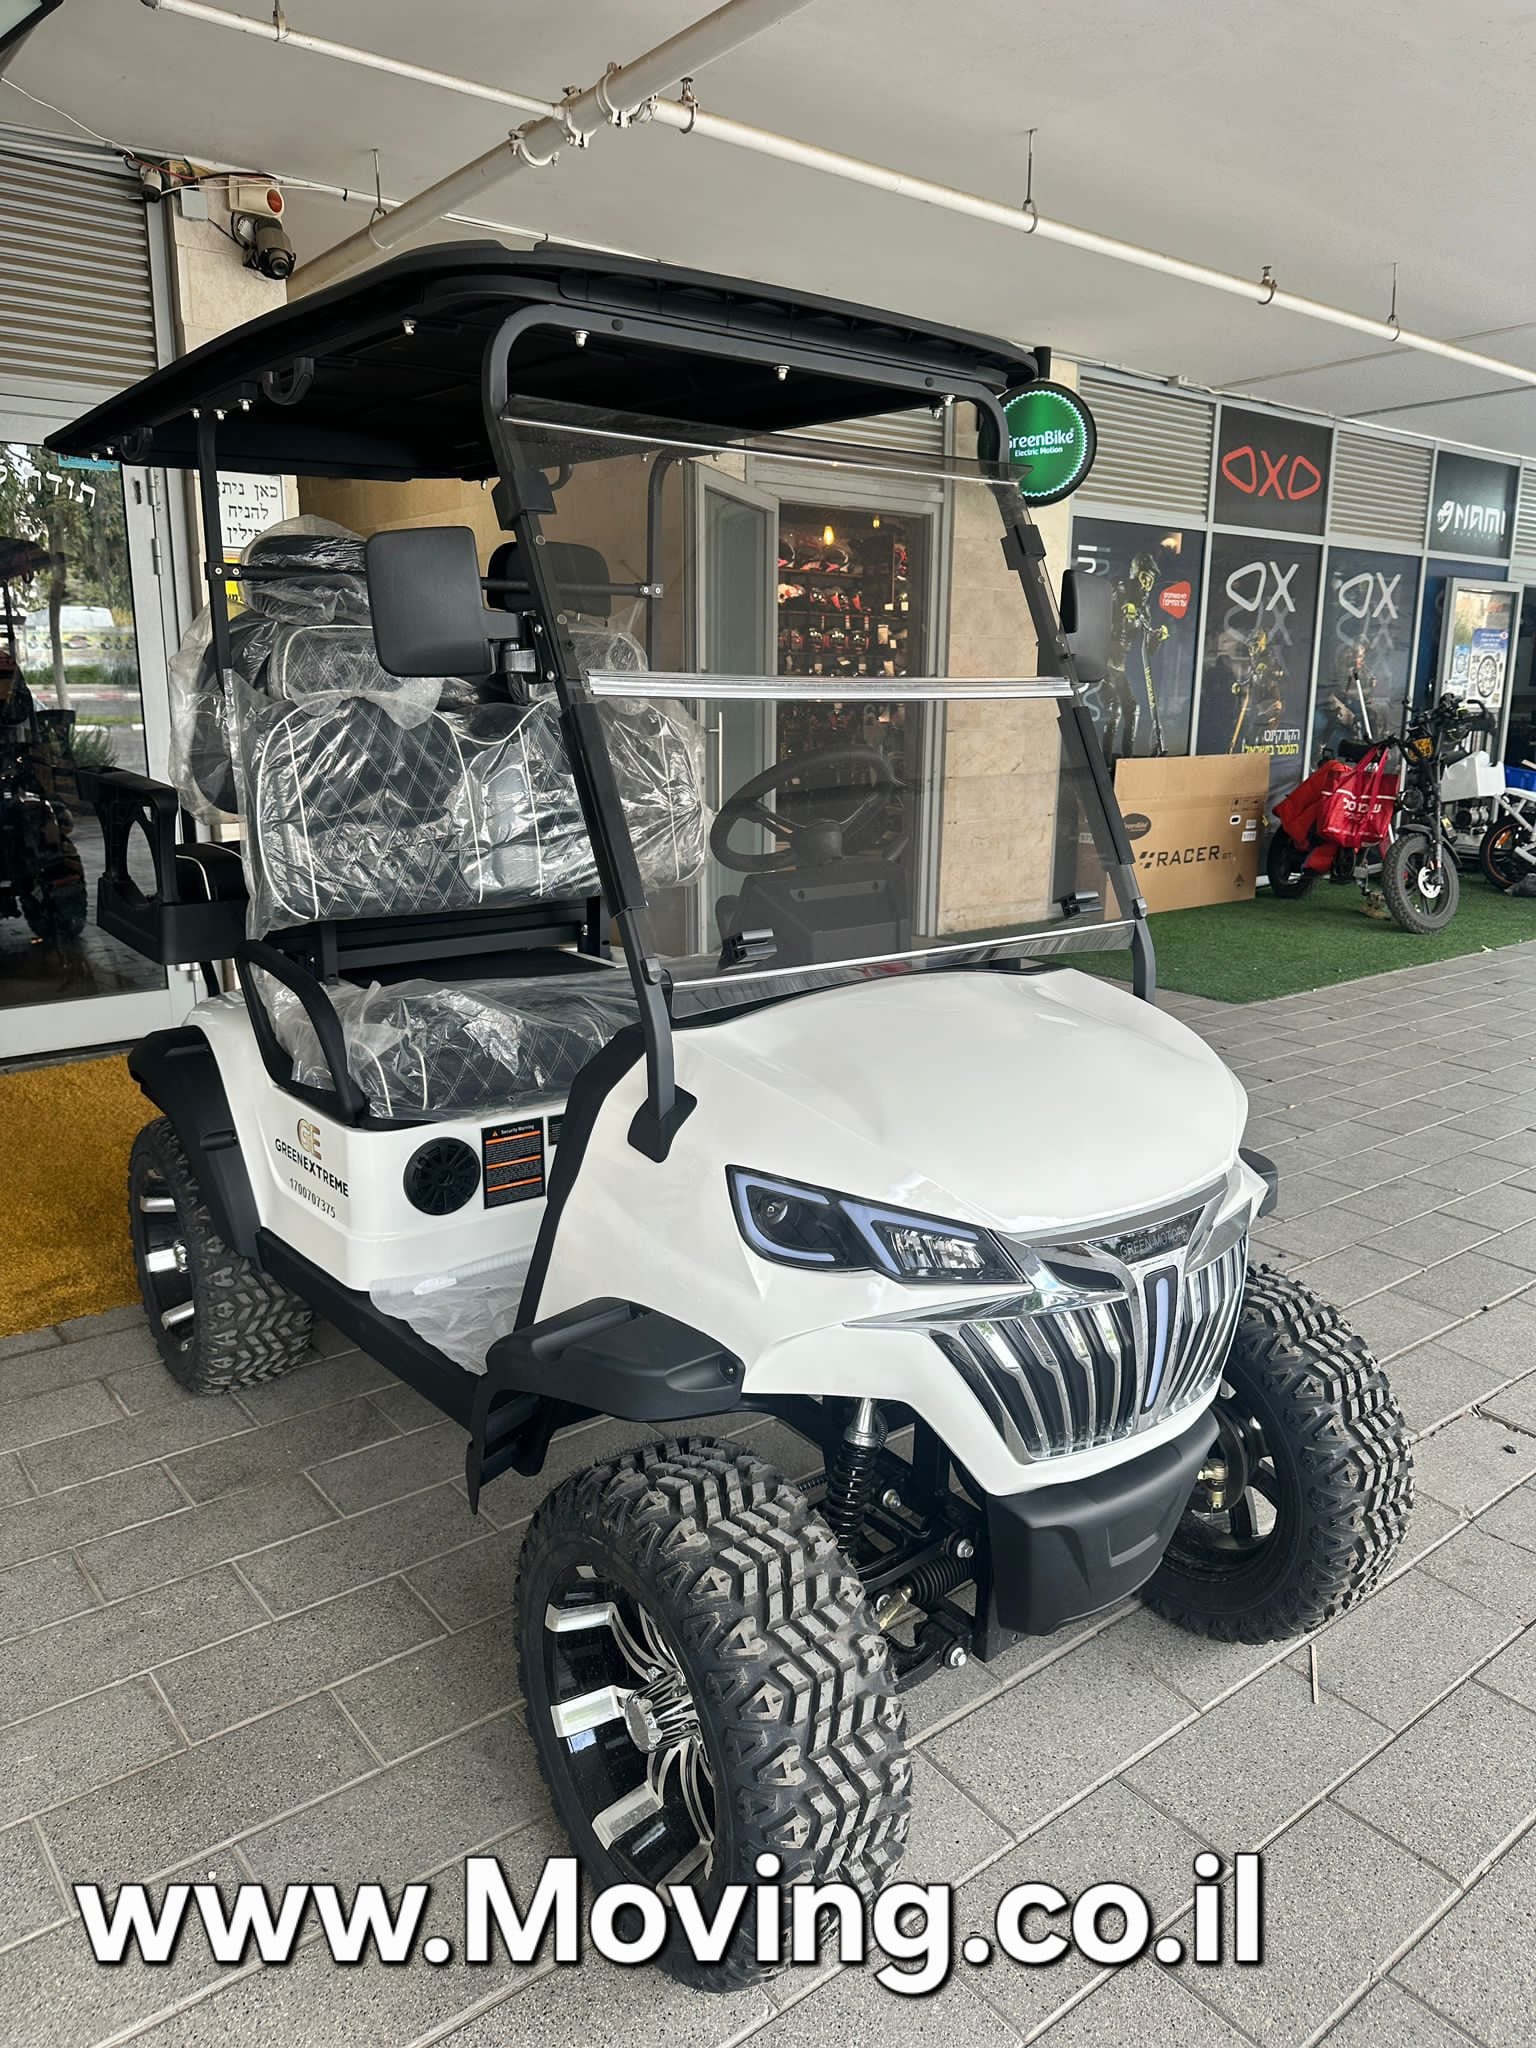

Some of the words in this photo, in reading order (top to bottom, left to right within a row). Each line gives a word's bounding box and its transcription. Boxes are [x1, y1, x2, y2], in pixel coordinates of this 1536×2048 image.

[1015, 448, 1039, 457] Electric
[1040, 446, 1063, 455] Motion
[1222, 446, 1321, 500] OXO
[254, 484, 278, 501] כאן
[228, 503, 269, 521] להניח
[1454, 503, 1506, 535] NAMI
[1226, 561, 1299, 612] OX
[1338, 572, 1402, 619] OX
[1156, 845, 1221, 867] RACER
[289, 1178, 336, 1219] 1700707375
[1120, 1237, 1153, 1258] GREEN
